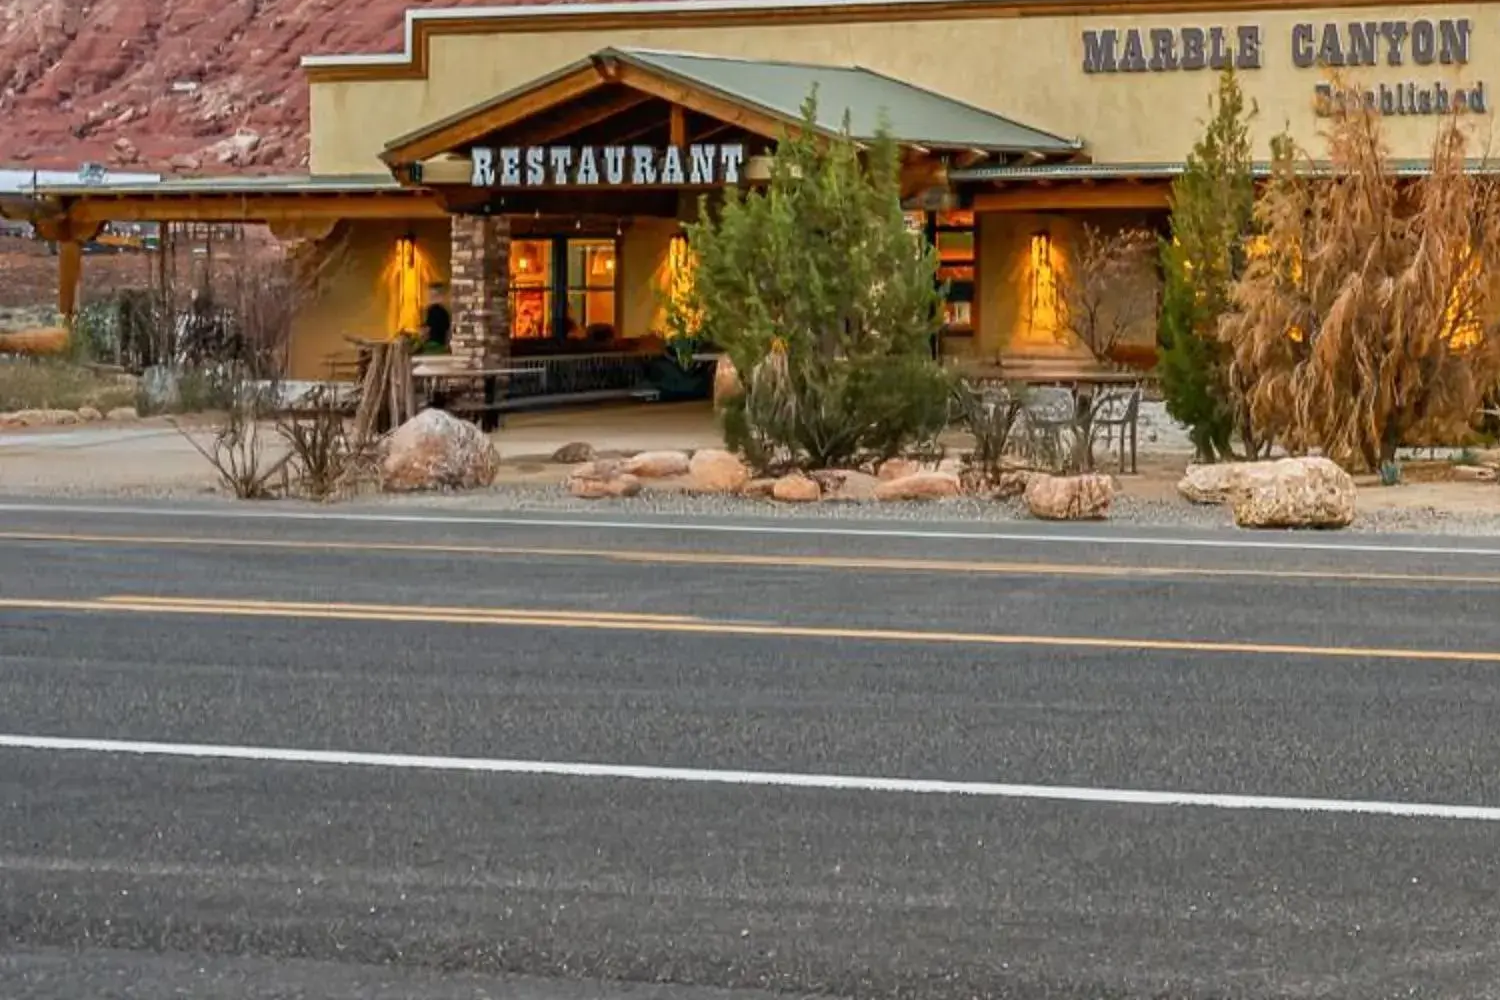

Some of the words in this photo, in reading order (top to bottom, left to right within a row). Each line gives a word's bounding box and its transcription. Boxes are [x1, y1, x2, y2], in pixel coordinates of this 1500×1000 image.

[1082, 25, 1263, 73] MARBLE
[1291, 19, 1474, 68] CANYON
[1313, 77, 1488, 117] Eablished
[471, 144, 744, 186] RESTAURANT
